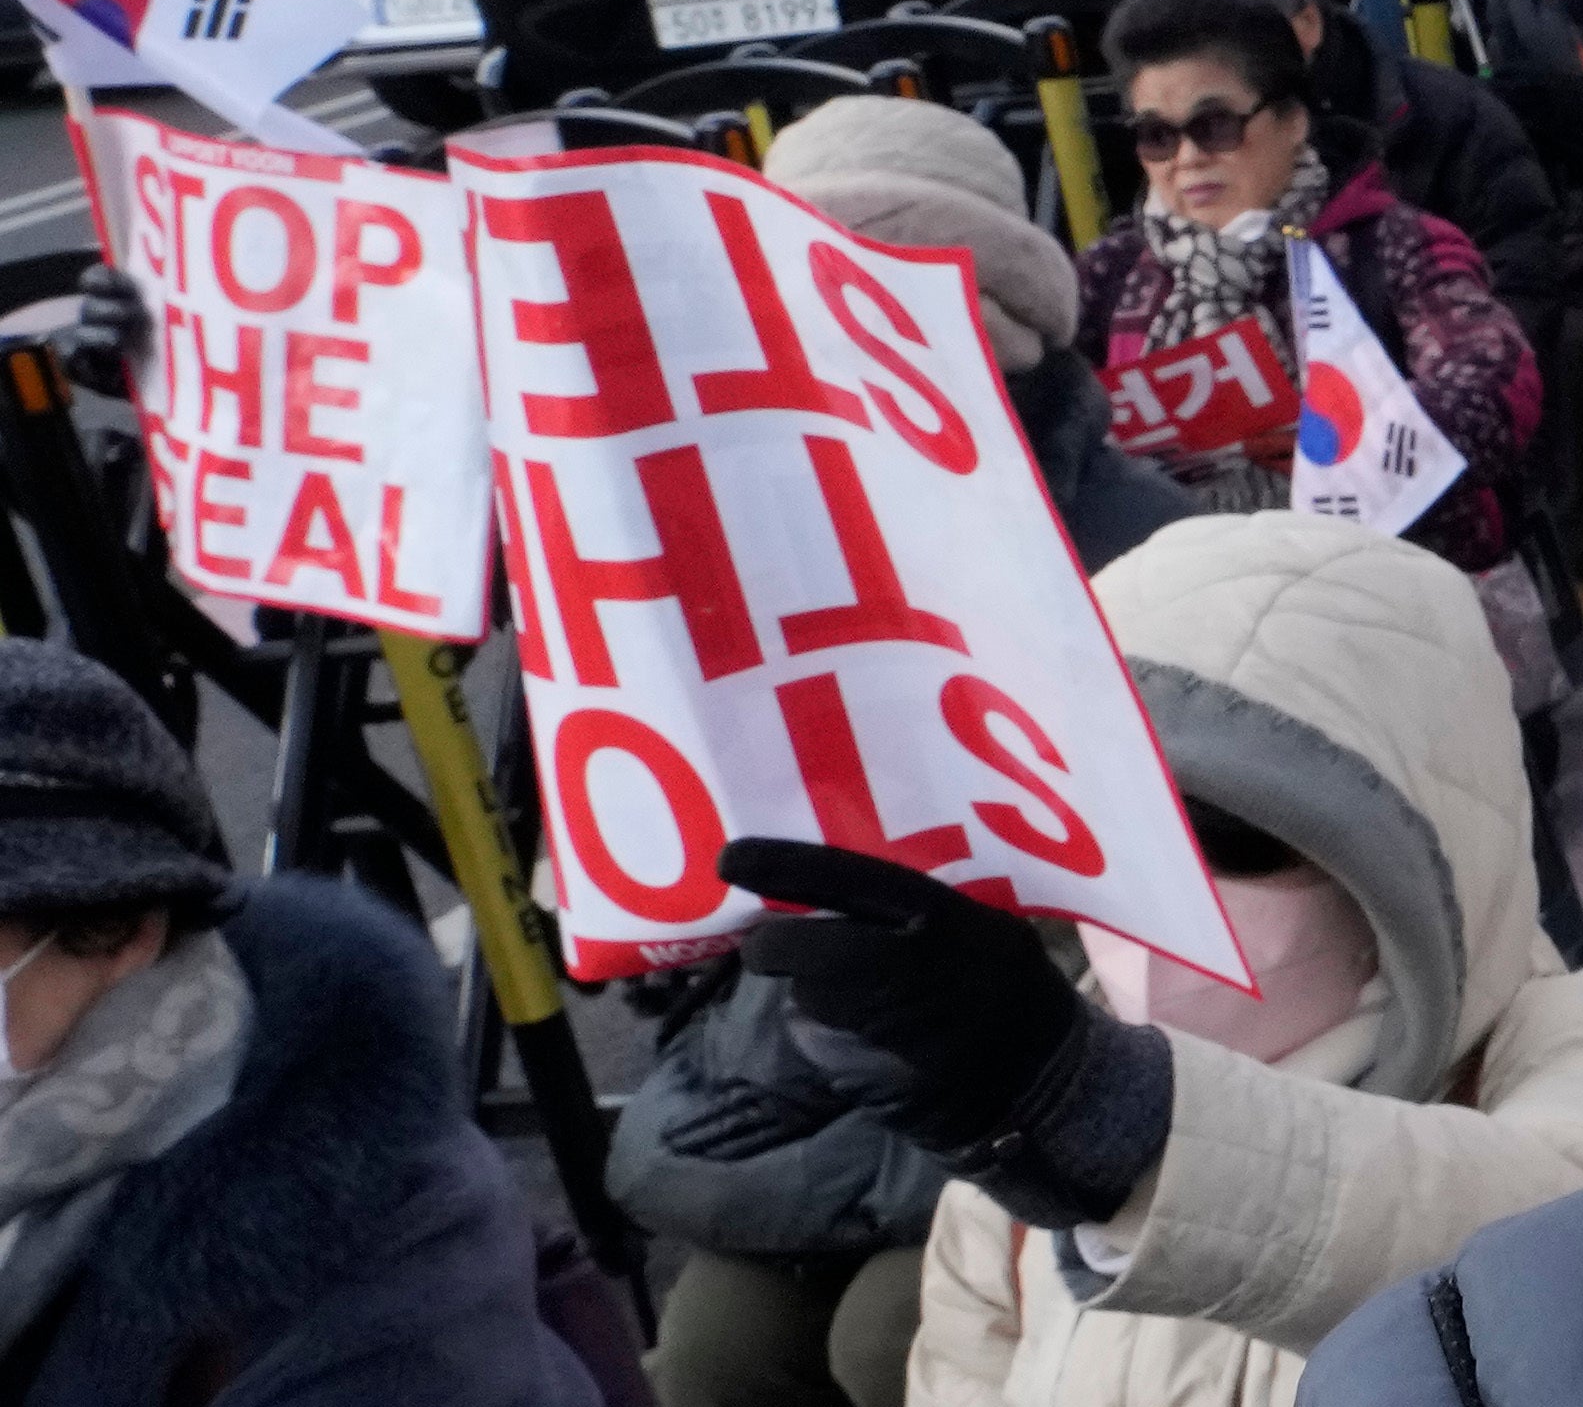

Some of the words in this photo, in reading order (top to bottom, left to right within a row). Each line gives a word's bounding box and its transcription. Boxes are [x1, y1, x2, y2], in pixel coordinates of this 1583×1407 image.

[671, 6, 726, 41] 50
[134, 153, 424, 325] STOP
[164, 303, 371, 465] THE
[480, 190, 979, 477] STE
[553, 671, 1108, 925] STO
